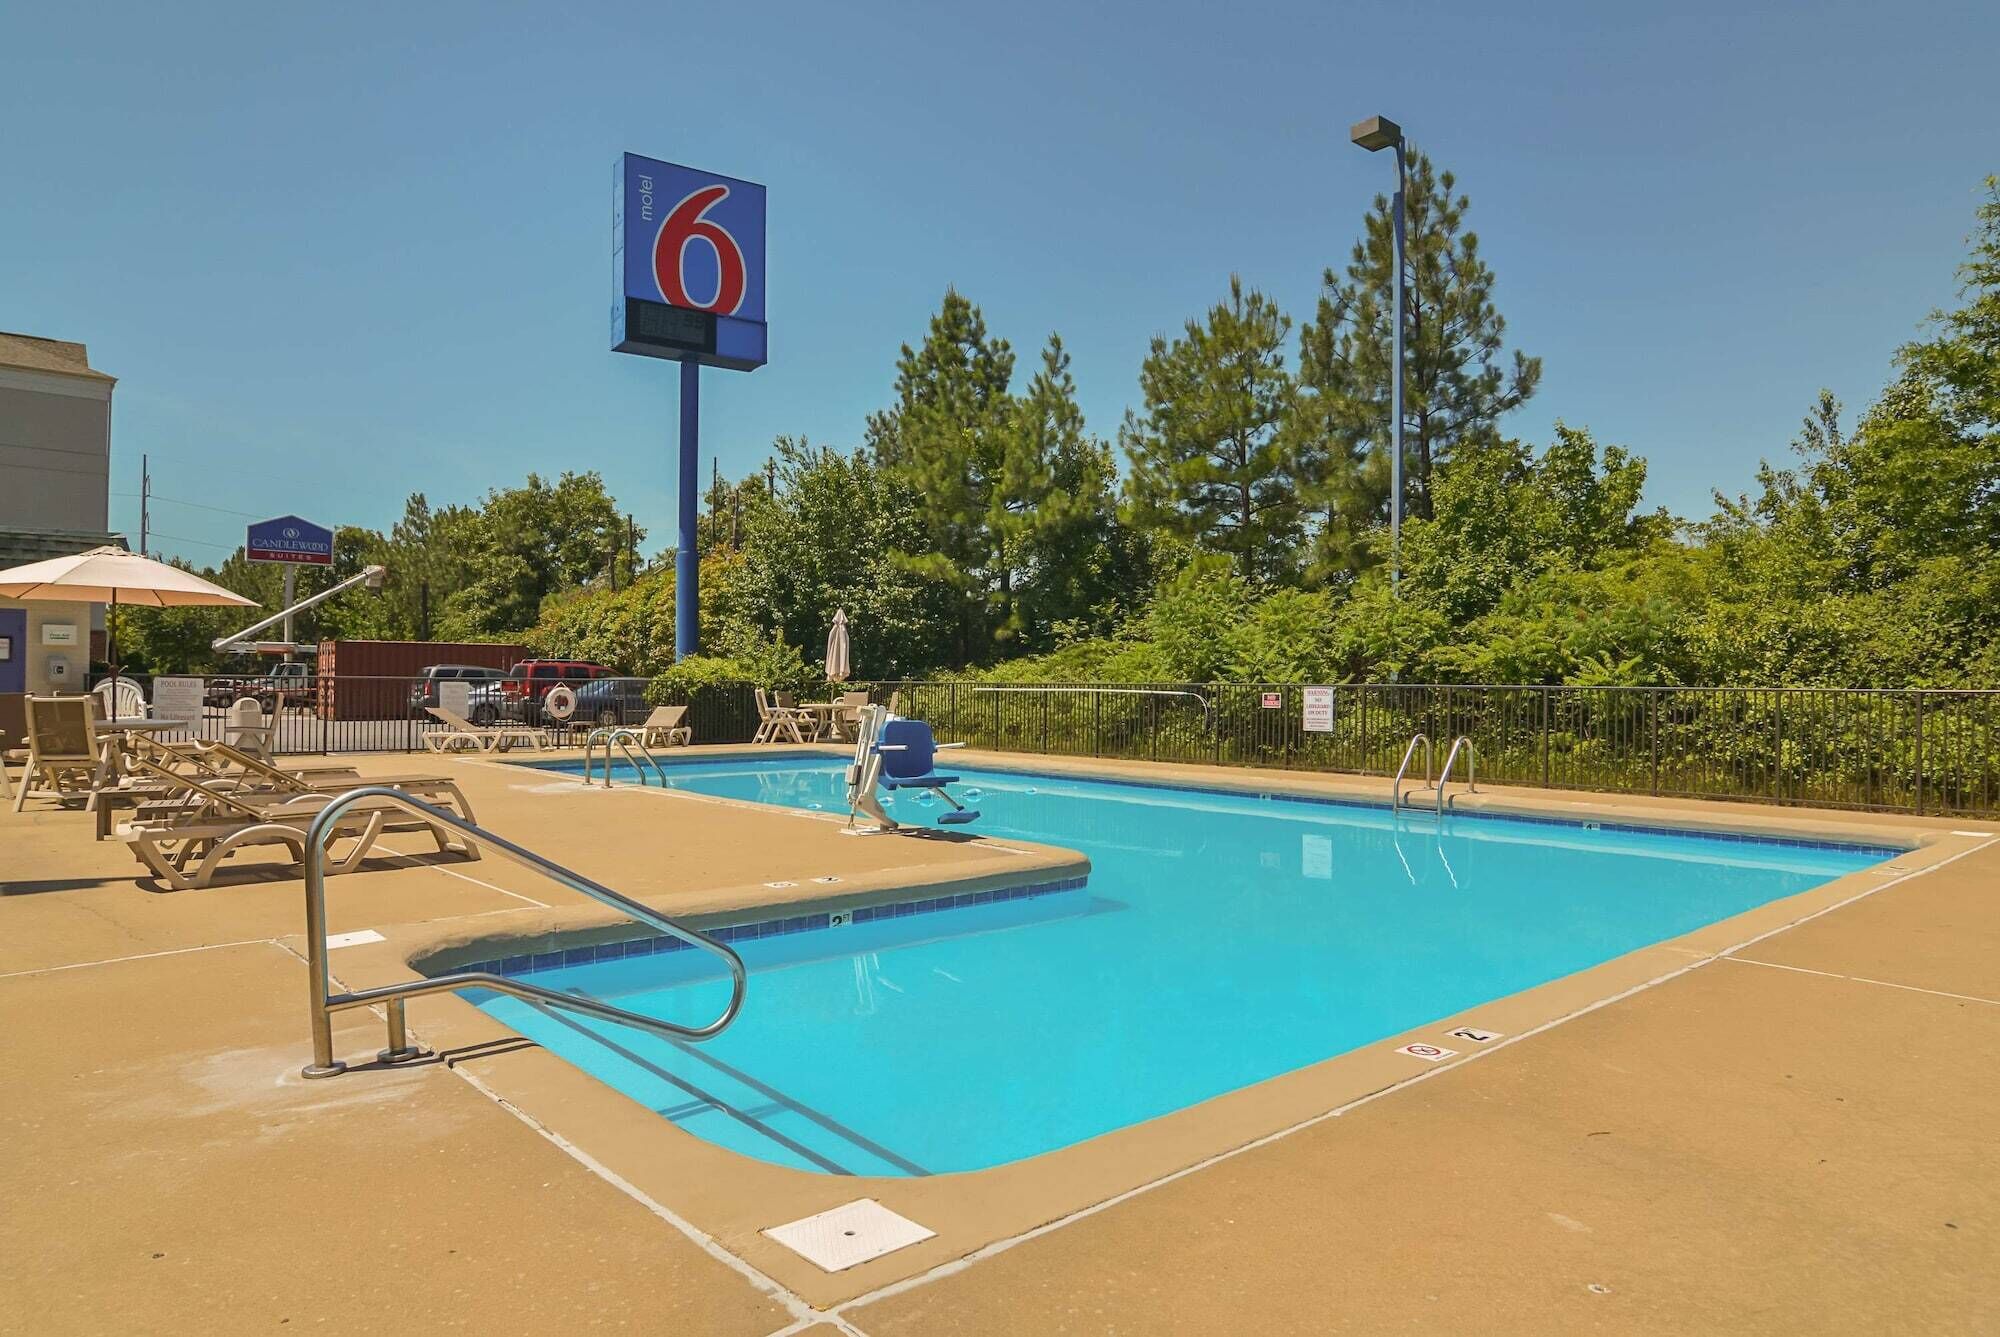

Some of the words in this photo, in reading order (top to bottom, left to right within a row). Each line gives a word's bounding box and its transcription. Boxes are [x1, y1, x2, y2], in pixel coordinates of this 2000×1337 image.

[639, 175, 652, 221] motel
[652, 184, 746, 315] 6
[252, 538, 328, 552] CANDLEWOOD
[269, 552, 312, 560] SUITES
